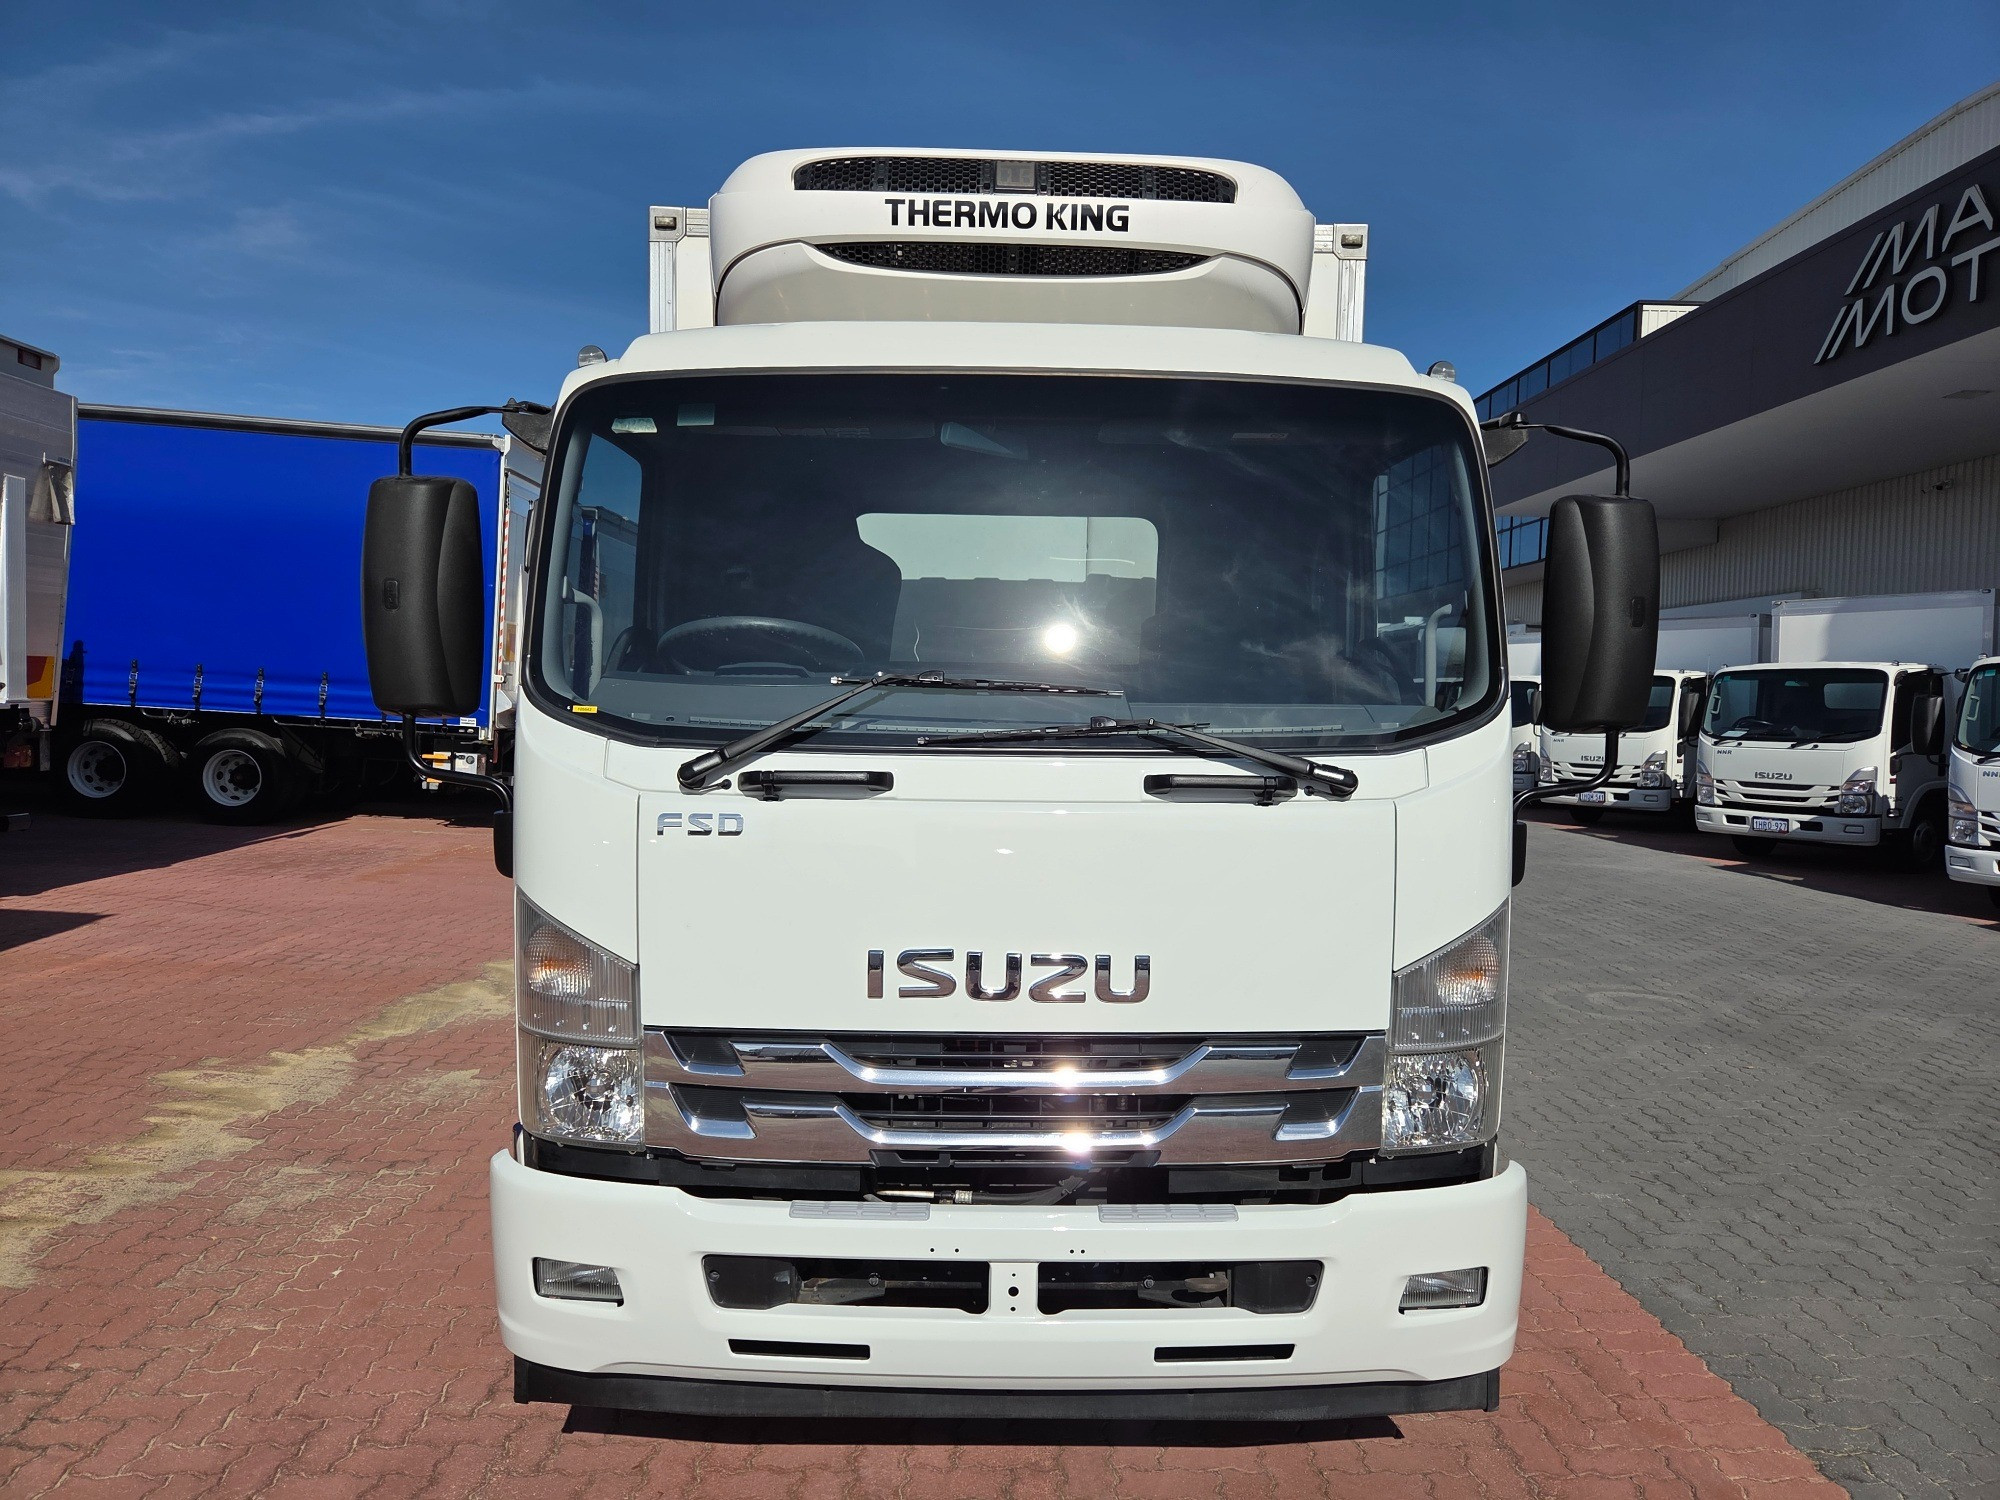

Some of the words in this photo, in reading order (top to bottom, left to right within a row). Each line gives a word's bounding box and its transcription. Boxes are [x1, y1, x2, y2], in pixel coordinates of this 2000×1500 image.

[884, 198, 1037, 230] THERMO
[1046, 202, 1130, 232] KING
[1754, 771, 1793, 781] ISUZU
[1982, 770, 2000, 778] NN
[657, 812, 744, 836] FSD
[867, 948, 1151, 1004] ISUZU
